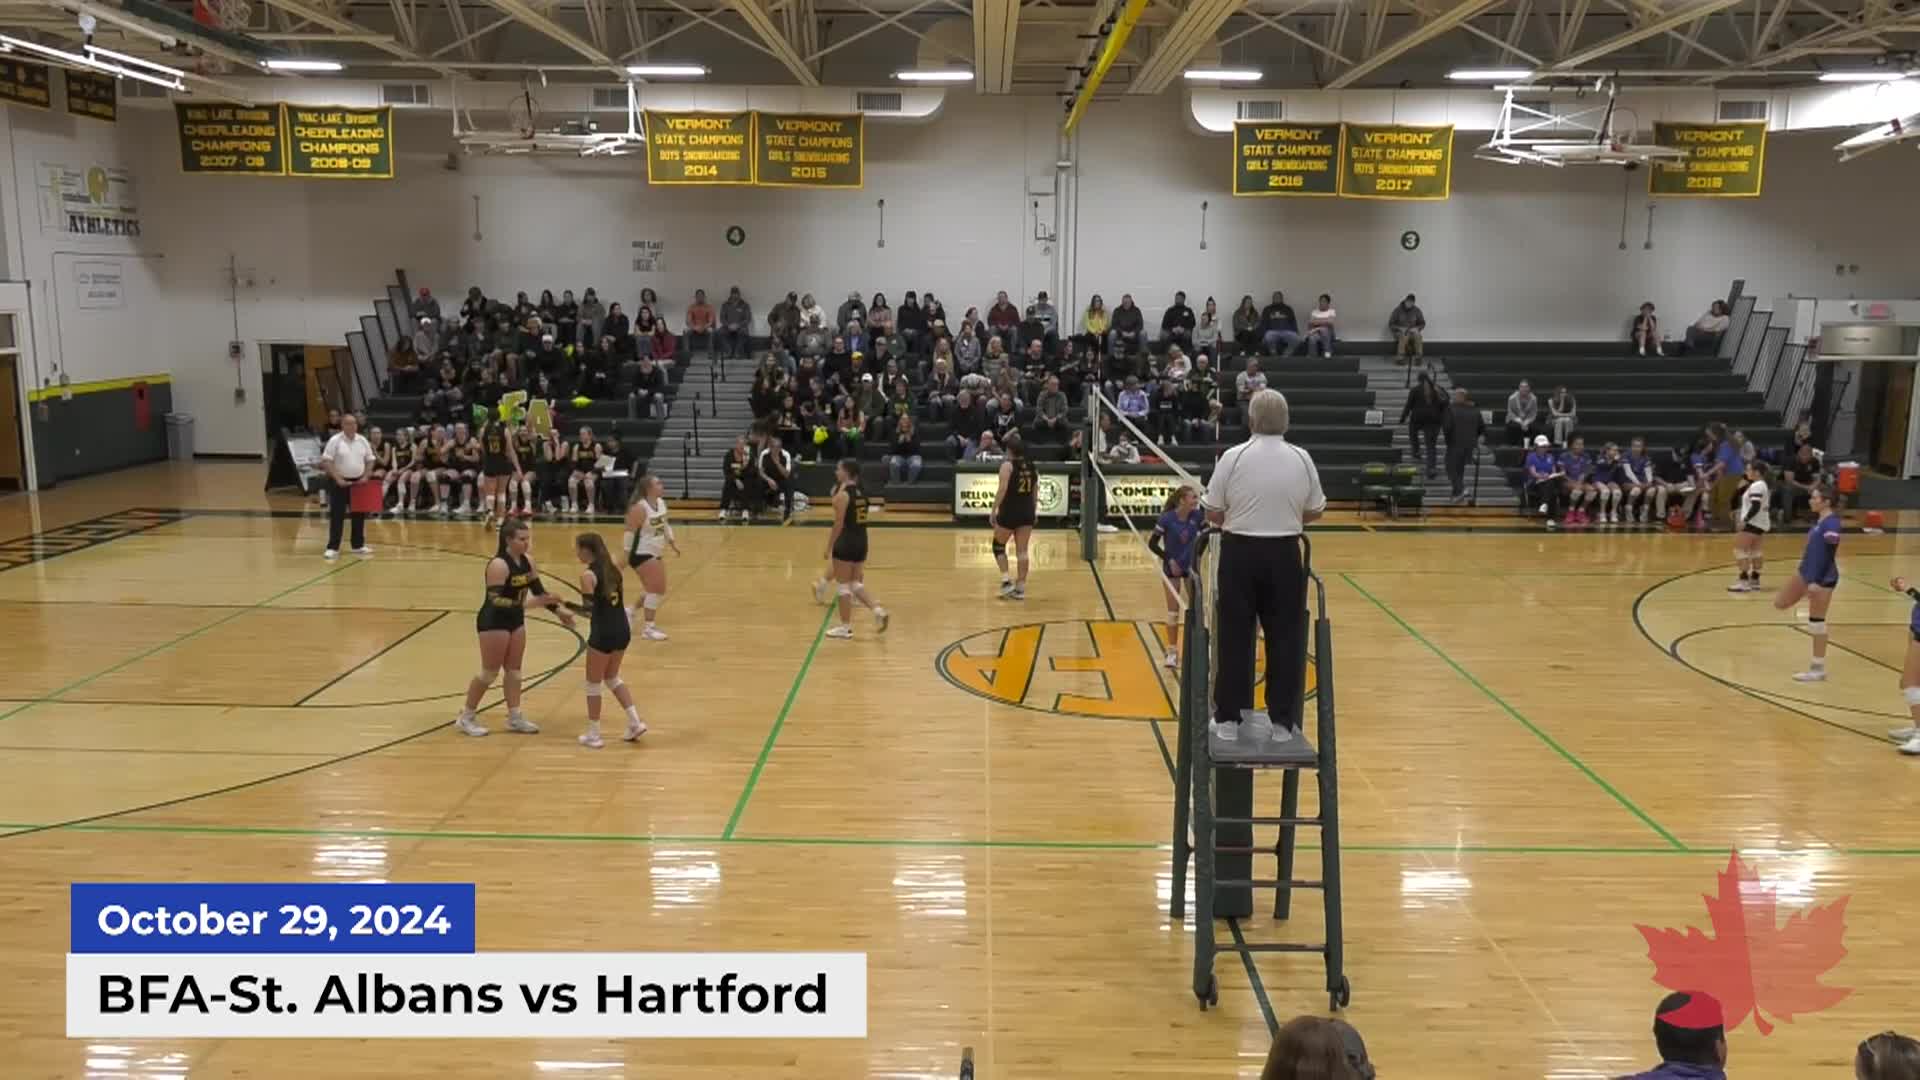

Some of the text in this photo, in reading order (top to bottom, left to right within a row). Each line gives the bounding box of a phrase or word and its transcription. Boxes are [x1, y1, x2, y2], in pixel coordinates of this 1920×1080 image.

[183, 125, 276, 137] CHEERLEADING
[666, 119, 732, 130] VERMONT
[776, 119, 843, 132] VERMONT
[294, 126, 385, 139] CHEERLEADING
[1255, 128, 1322, 140] VERMONT
[1364, 132, 1433, 145] VERMONT
[1674, 129, 1744, 142] VERMONT
[655, 134, 744, 145] STATE CHAMPIONS
[766, 135, 853, 148] STATE CHAMPIONS
[191, 141, 272, 152] CHAMPIONS
[300, 141, 380, 154] CHAMPIONS
[1243, 144, 1333, 157] STATE CHAMPIONS
[1696, 144, 1755, 158] CHAMPIONS
[1352, 148, 1443, 161] STATE CHAMPIONS
[684, 165, 718, 177] 2014
[791, 167, 828, 179] 2015
[1375, 179, 1413, 191] 2017
[68, 214, 142, 237] ATHLETICS
[1018, 477, 1032, 494] 21
[960, 490, 996, 500] BELLOW
